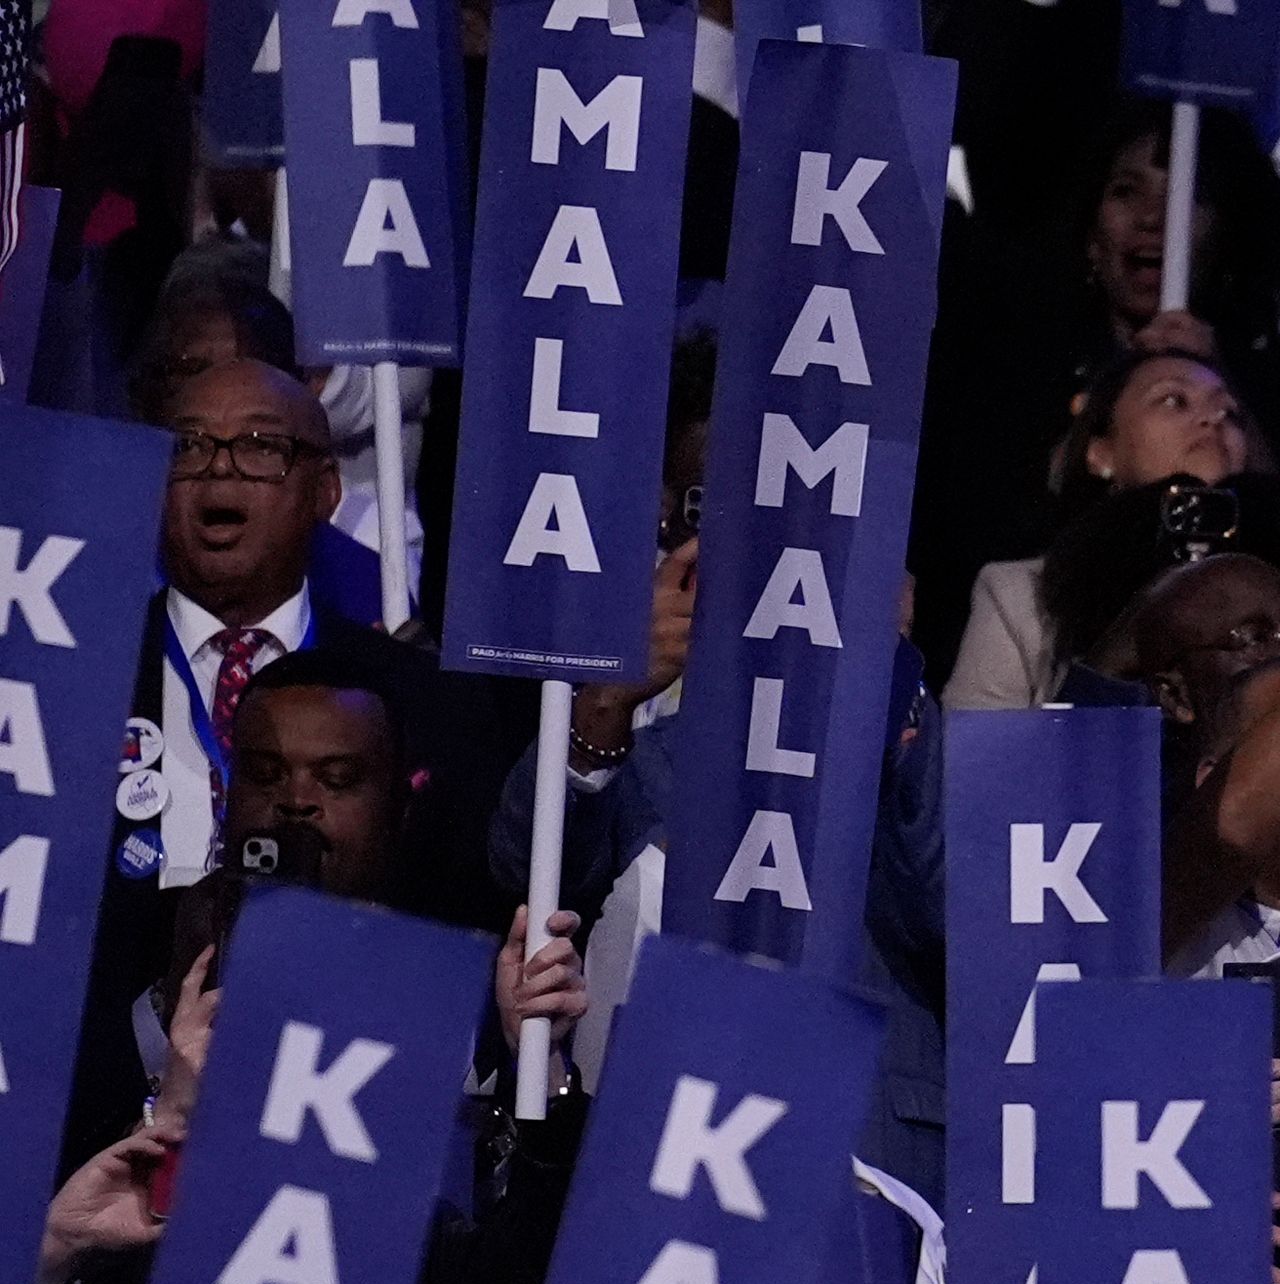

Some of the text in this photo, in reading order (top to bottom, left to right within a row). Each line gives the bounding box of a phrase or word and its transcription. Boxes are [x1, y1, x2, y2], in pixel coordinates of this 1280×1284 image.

[471, 647, 495, 658] PAID
[545, 655, 565, 665] FOR
[565, 657, 620, 669] PRESIDENT
[715, 150, 889, 911] KAMALA
